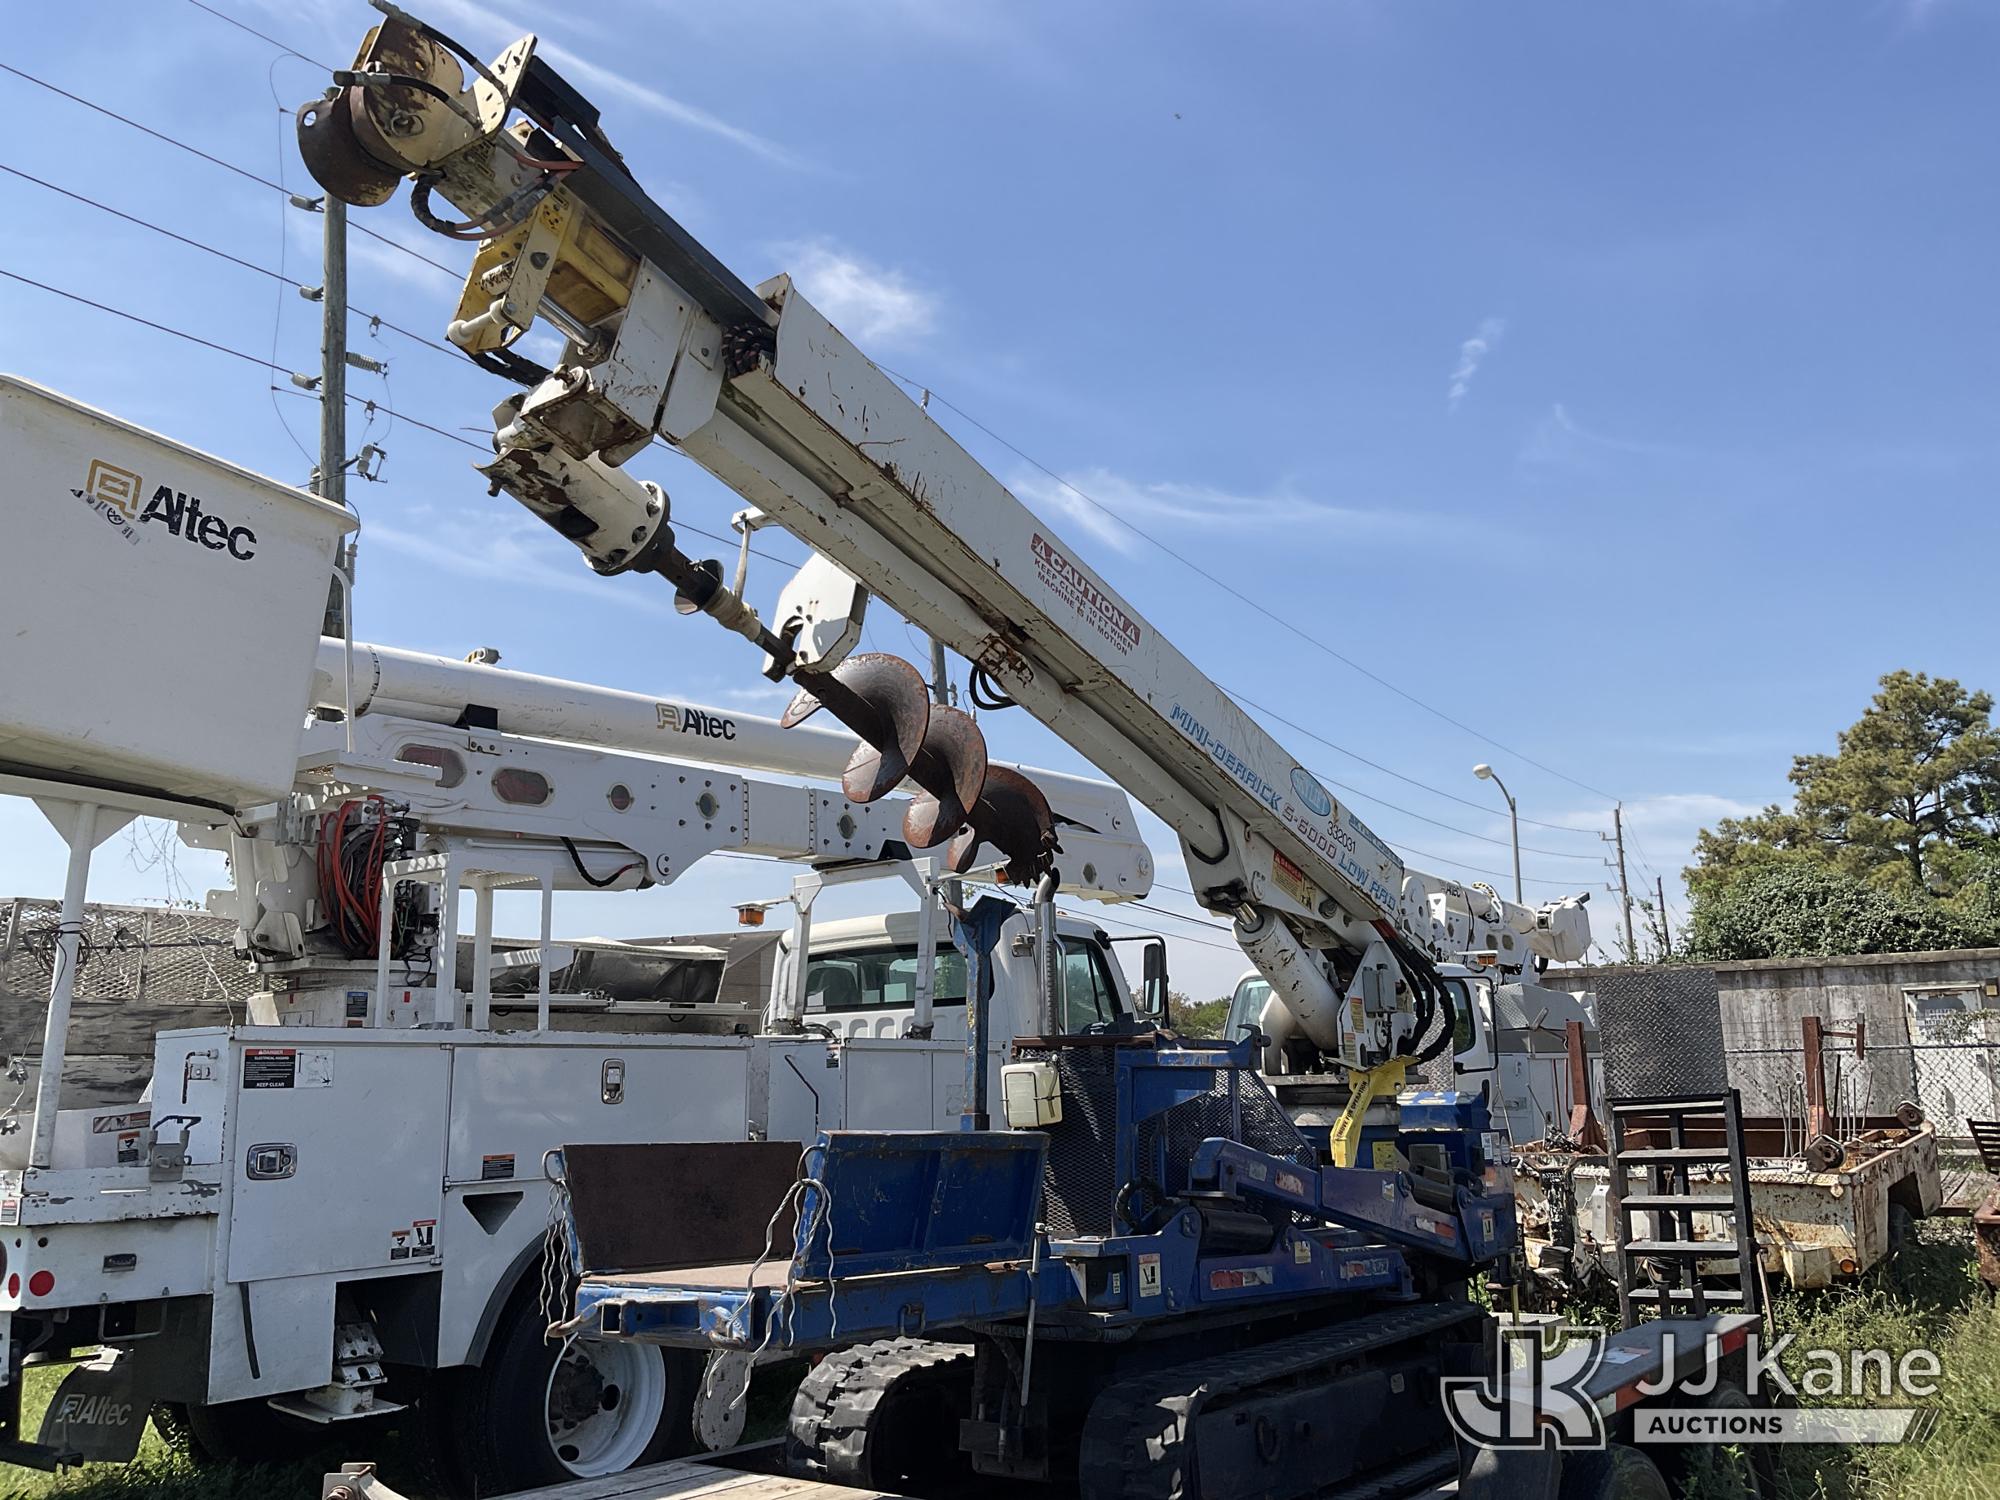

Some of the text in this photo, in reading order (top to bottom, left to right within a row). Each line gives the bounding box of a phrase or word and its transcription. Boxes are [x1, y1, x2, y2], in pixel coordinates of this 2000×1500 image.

[139, 485, 257, 561] Altec
[1034, 558, 1133, 651] KEEP CLEAR 10 FT WHEN
[1038, 572, 1075, 609] MACHINE
[1086, 615, 1096, 627] IN
[1097, 627, 1128, 656] MOTION
[1050, 551, 1125, 631] CAUTION
[681, 708, 736, 740] Altec
[1170, 702, 1282, 812] MINI-DERRICK
[1338, 852, 1369, 886] LOW
[1327, 820, 1356, 854] 332031
[77, 1395, 132, 1426] Altec
